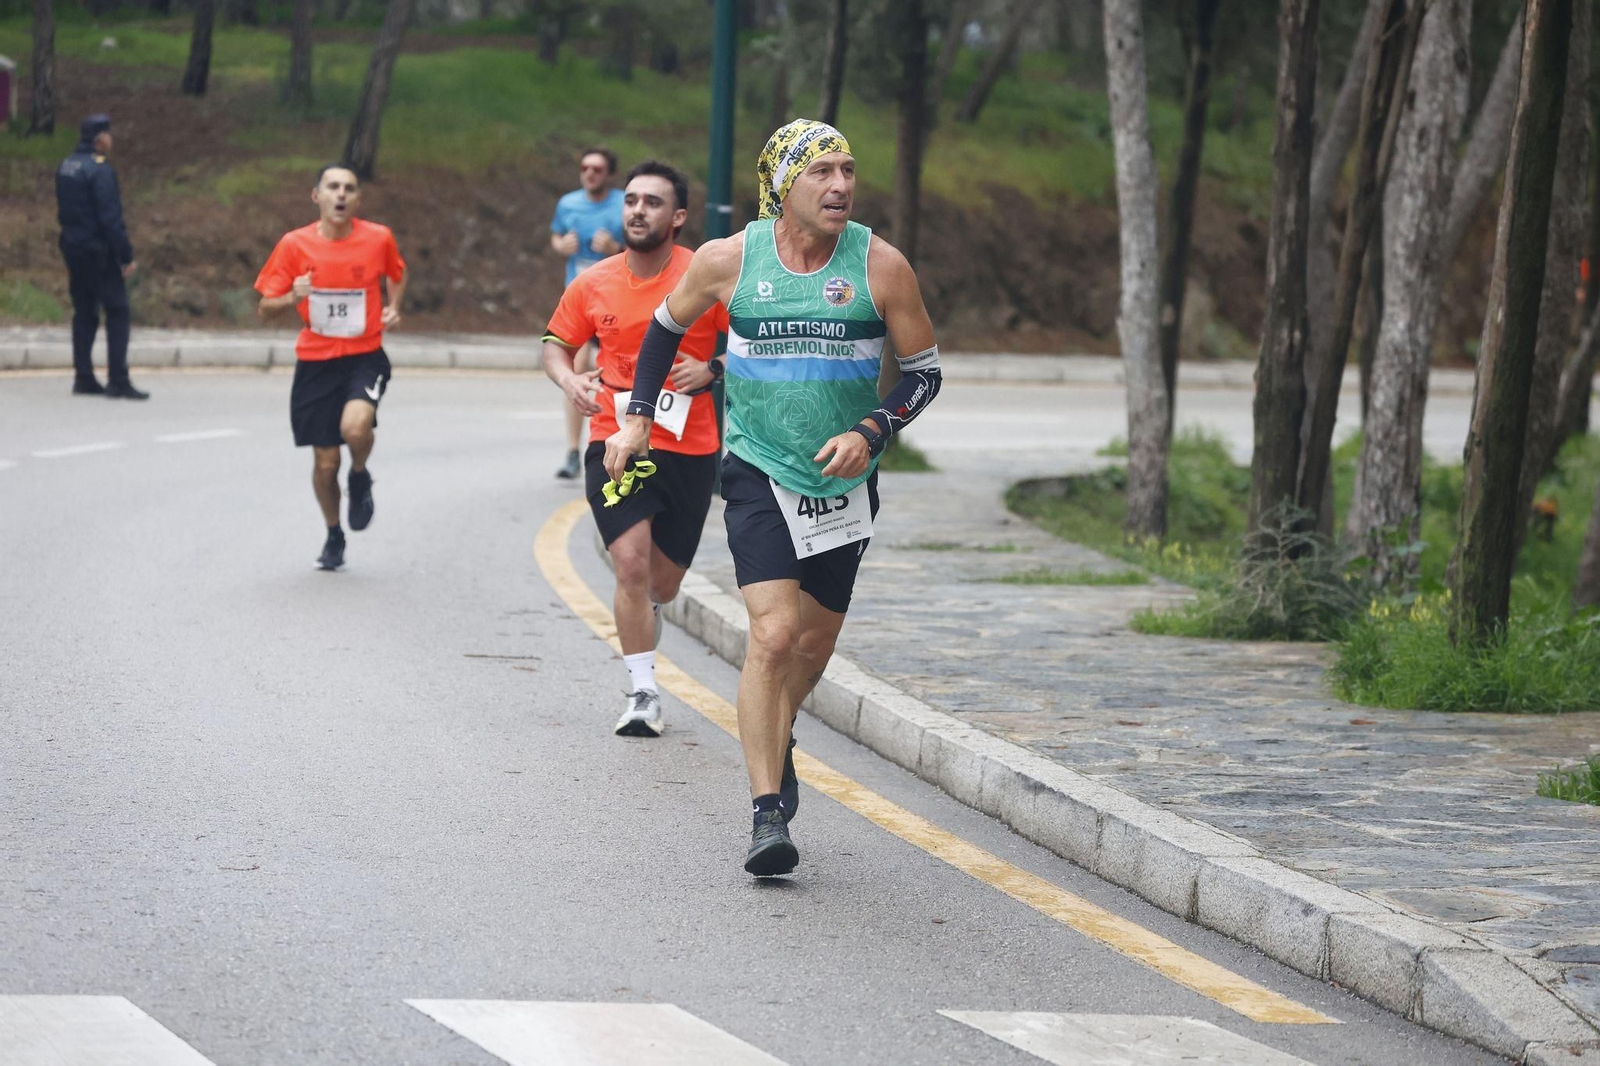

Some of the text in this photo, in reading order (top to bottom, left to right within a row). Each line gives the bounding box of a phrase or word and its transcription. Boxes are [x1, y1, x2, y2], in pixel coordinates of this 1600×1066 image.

[326, 302, 348, 317] 18
[758, 321, 846, 338] ATLETISMO
[746, 340, 856, 358] TORREMOLINOS
[905, 383, 927, 411] LURBEL
